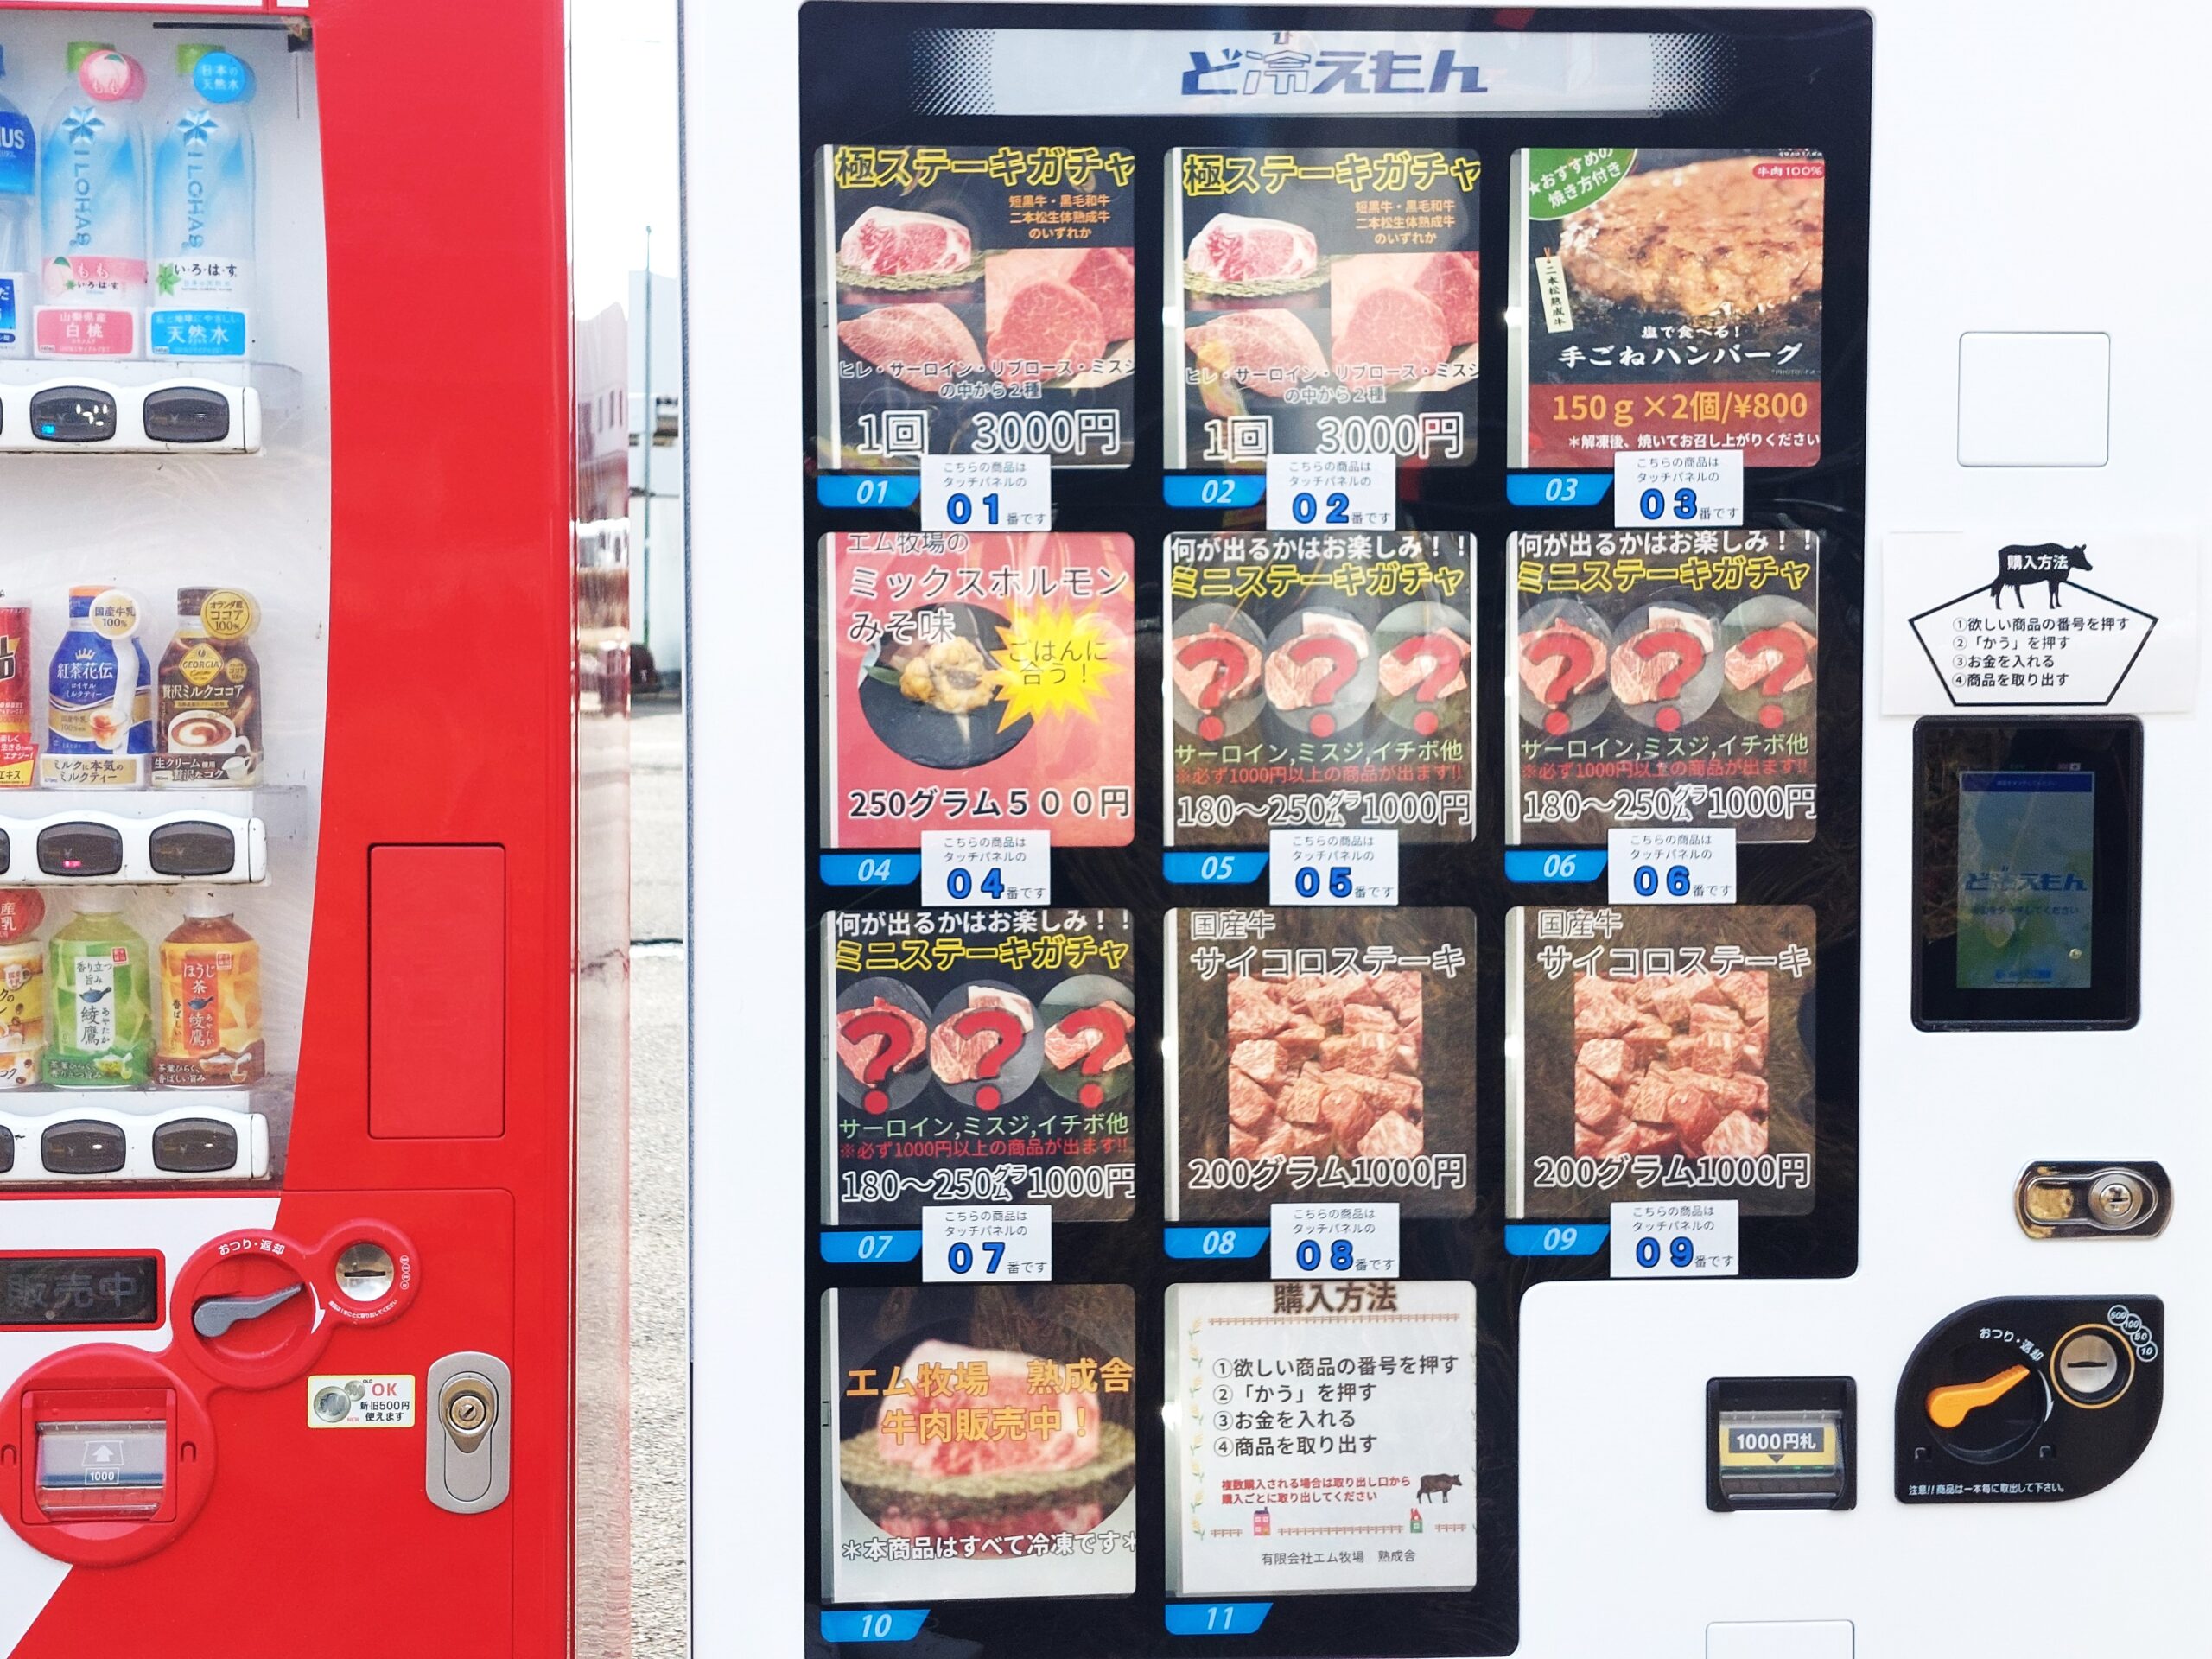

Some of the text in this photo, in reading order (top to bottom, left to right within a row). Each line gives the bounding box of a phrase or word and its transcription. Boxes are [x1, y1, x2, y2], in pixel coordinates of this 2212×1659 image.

[201, 64, 239, 76] 日本の
[1180, 48, 1489, 96] ど冷えもん
[202, 78, 239, 91] 天然水
[834, 145, 1135, 188] 極ステーキガチャ
[1182, 150, 1481, 197] 極ステーキガチャ
[1757, 165, 1823, 178] 牛肉100%
[1548, 164, 1623, 210] 焼き方付き
[1008, 194, 1111, 208] 短黒牛・黒毛和牛
[1354, 199, 1455, 214] 短黒牛・黒毛和牛
[1028, 226, 1092, 240] のいずれか
[1374, 232, 1437, 245] のいずれか
[66, 323, 103, 338] 白桃
[167, 325, 229, 345] 天然水
[1557, 342, 1803, 368] 手ごねハンバーグ
[857, 408, 1121, 457] 1回 3000円
[1203, 411, 1464, 464] 1回 3000円
[944, 461, 1027, 474] こちらの商品は
[1288, 461, 1371, 473] こちらの商品は
[1637, 456, 1719, 468] こちらの商品は
[944, 477, 1027, 489] タッチパネルの
[1288, 475, 1371, 487] タッチパネルの
[1637, 471, 1719, 484] タッチパネルの
[856, 480, 889, 505] 01
[1200, 480, 1236, 504] 02
[1545, 477, 1579, 502] 03
[2007, 554, 2069, 571] 購入方法
[850, 566, 1130, 599] ミックスホルモン
[1171, 561, 1465, 598] ミニステーキガチャ
[1517, 555, 1811, 594] ミニステーキガチャ
[94, 607, 136, 616] 国産牛乳
[210, 610, 243, 620] ココア
[848, 610, 957, 643] みそ味
[1009, 640, 1109, 662] ごはんに
[56, 662, 113, 680] 紅茶花伝
[54, 760, 124, 772] ミルクに本気の
[944, 837, 1027, 849] こちらの商品は
[1292, 836, 1374, 847] こちらの商品は
[1630, 834, 1713, 845] こちらの商品は
[944, 852, 1027, 863] タッチパネルの
[1292, 850, 1374, 861] タッチパネルの
[1630, 849, 1713, 861] タッチパネルの
[858, 859, 891, 881] 04
[1200, 856, 1235, 880] 05
[1543, 854, 1576, 878] 06
[1191, 911, 1275, 940] 国産牛
[1538, 909, 1623, 939] 国産牛
[836, 935, 1129, 972] ミニステーキガチャ
[1537, 944, 1812, 980] サイコロステーキ
[76, 961, 112, 972] 香り立つ
[183, 963, 215, 978] ほうじ
[1190, 944, 1465, 981] サイコロステーキ
[85, 975, 103, 985] 旨み
[192, 980, 207, 994] 茶
[80, 1006, 99, 1046] 綾鷹
[101, 1007, 110, 1044] あやたか
[172, 999, 181, 1036] 香ばしい
[188, 1013, 206, 1047] 綾鷹
[158, 1073, 206, 1083] 香ばしい旨み
[1188, 1154, 1466, 1191] 200グラム1000円
[1534, 1152, 1811, 1190] 200グラム1000円
[944, 1211, 1027, 1222] こちらの商品は
[1293, 1209, 1375, 1220] こちらの商品は
[1632, 1205, 1714, 1217] こちらの商品は
[944, 1225, 1027, 1237] タッチパネルの
[1293, 1223, 1375, 1234] タッチパネルの
[1632, 1220, 1714, 1231] タッチパネルの
[218, 1239, 285, 1255] おつり・返却
[857, 1236, 893, 1259] 07
[1202, 1230, 1236, 1254] 08
[1543, 1227, 1577, 1251] 09
[1273, 1283, 1397, 1314] 購入方法
[1979, 1327, 2044, 1362] おつり・返却
[847, 1357, 1134, 1398] エム牧場 熟成舎
[372, 1382, 397, 1396] OK
[365, 1412, 404, 1421] 使えます
[881, 1406, 1087, 1445] 牛肉販売中！
[1736, 1433, 1816, 1451] 1000円札
[90, 1471, 114, 1481] 1000
[1222, 1476, 1411, 1491] 複数購入される場合は取り出し口から
[1222, 1491, 1377, 1505] 購入ごとに取り出してください
[1262, 1549, 1415, 1566] 有限会社エム牧場 熟成舎
[862, 1614, 892, 1638] 10
[1207, 1606, 1234, 1630] 11
